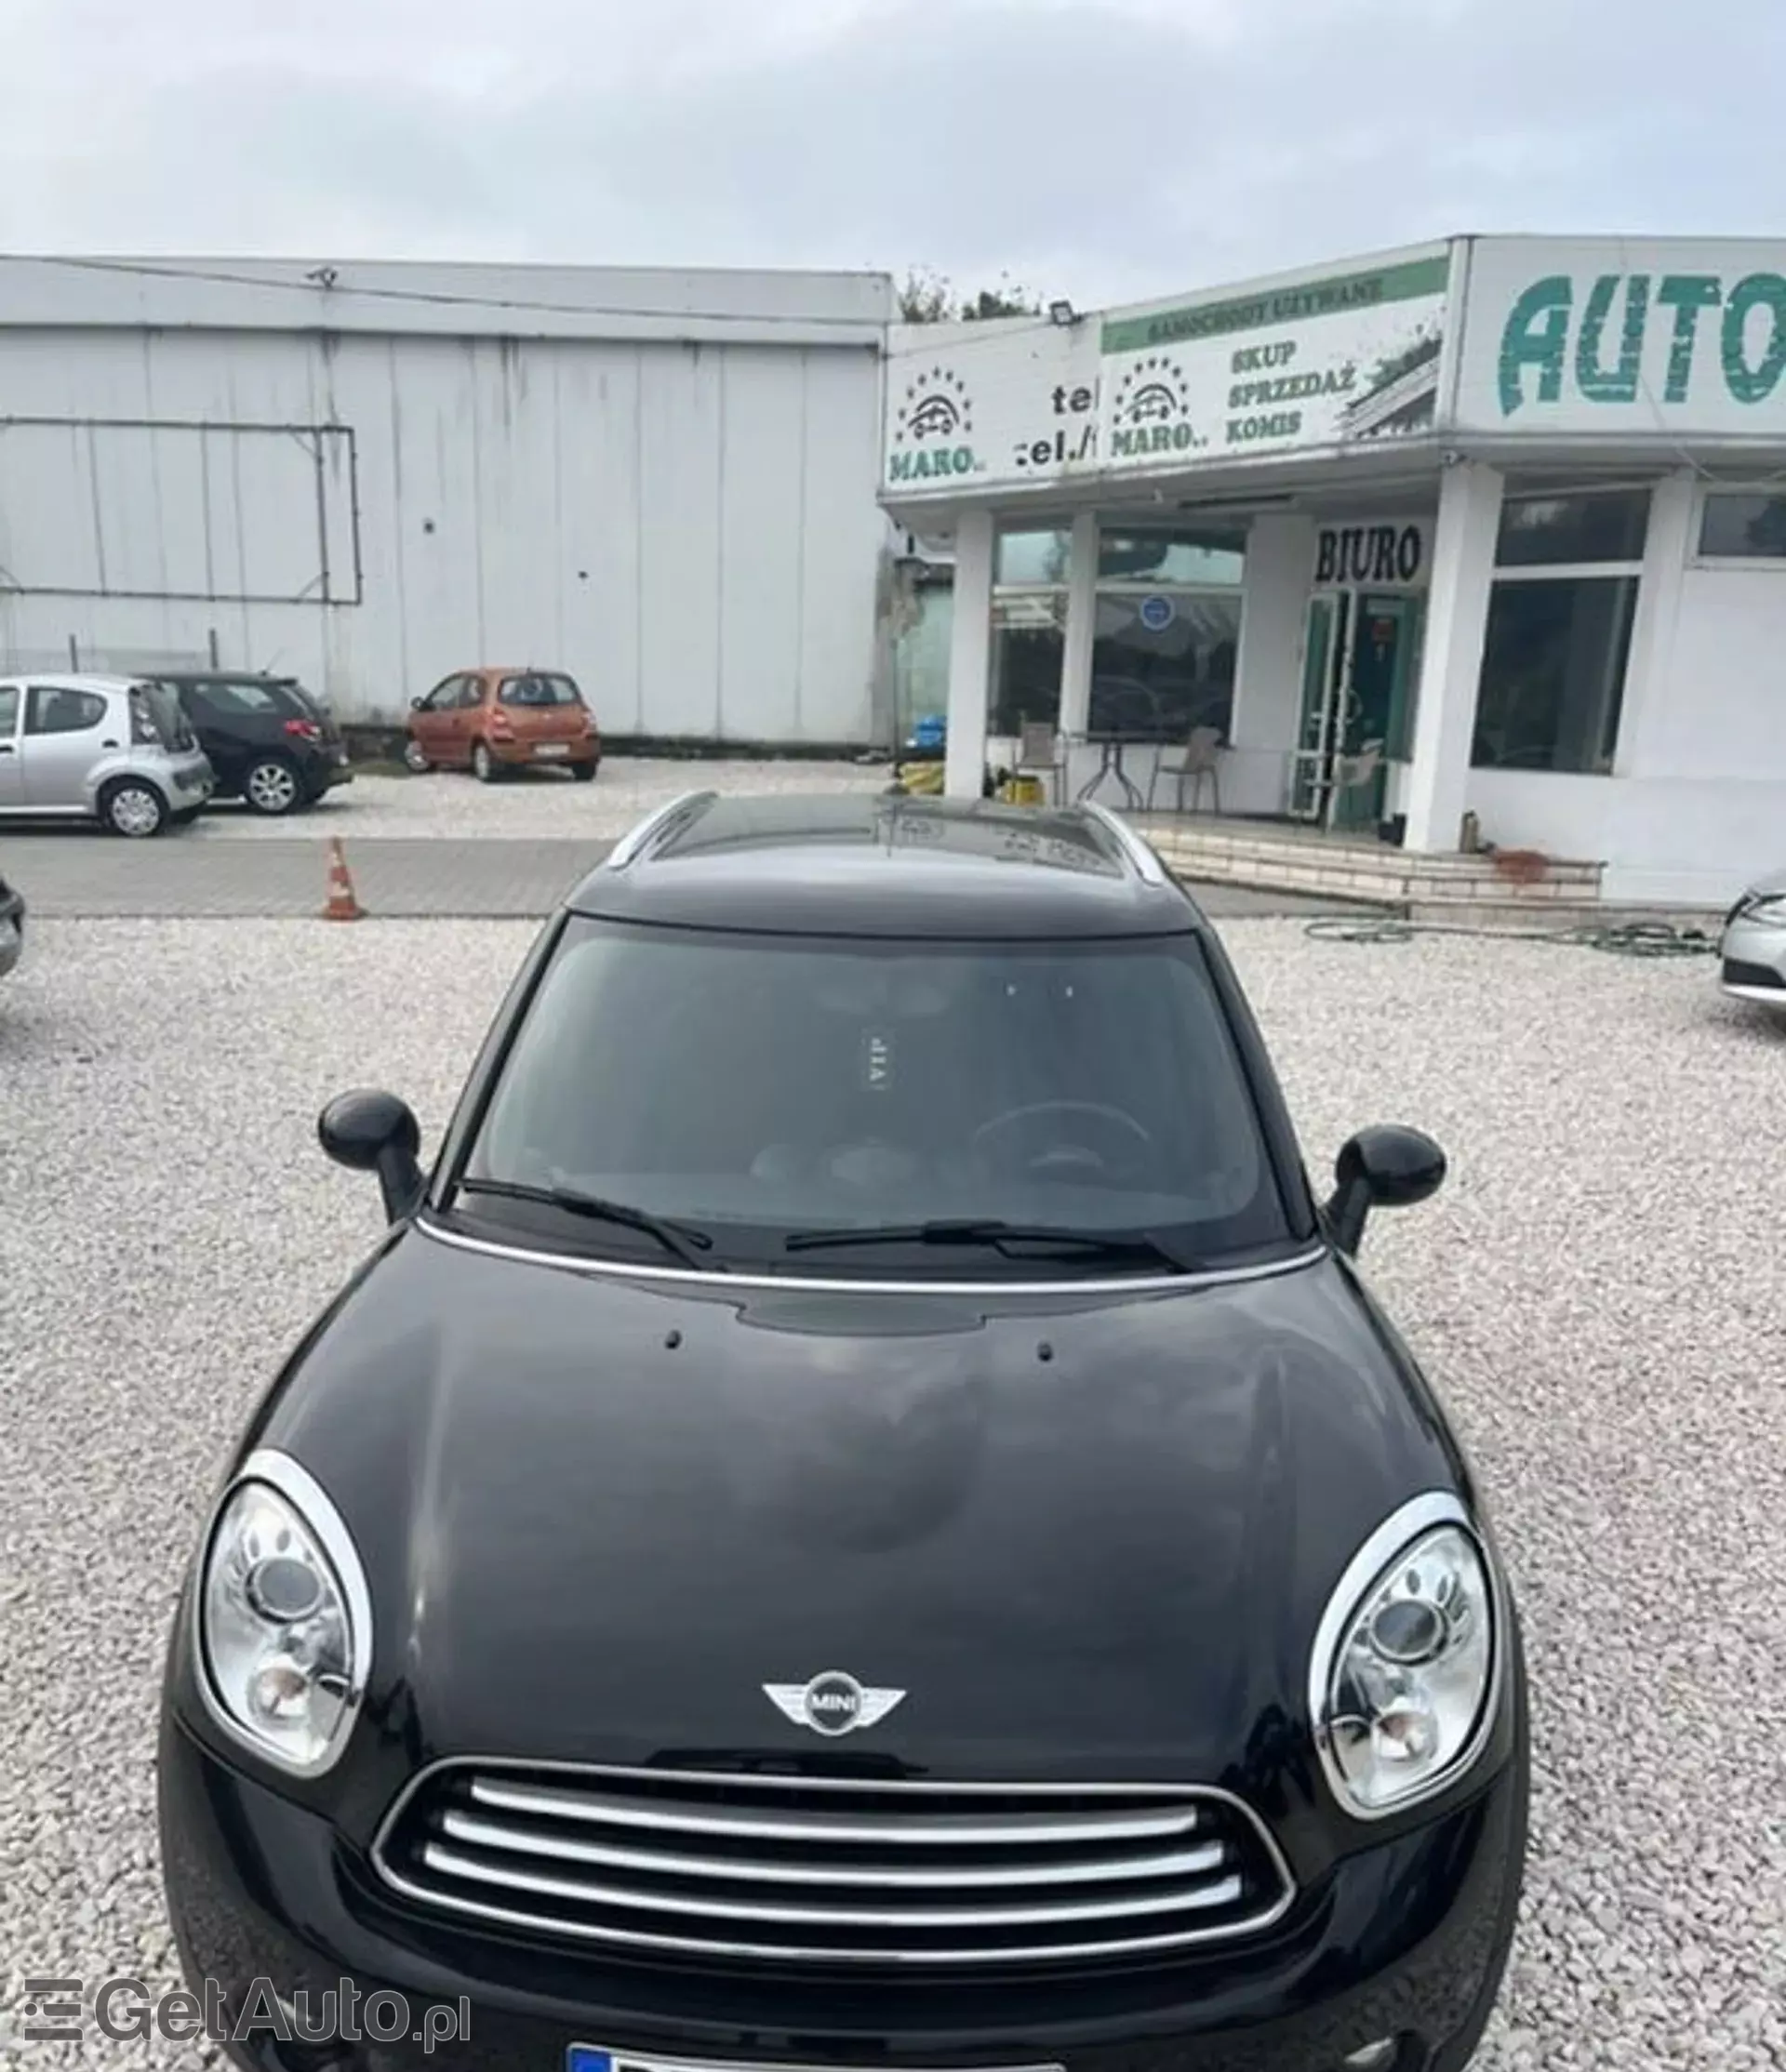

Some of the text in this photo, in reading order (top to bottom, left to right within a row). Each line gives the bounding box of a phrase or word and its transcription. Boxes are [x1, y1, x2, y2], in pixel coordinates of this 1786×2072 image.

[1232, 339, 1297, 375] SKUP
[1499, 272, 1786, 418] AUTO
[1228, 360, 1358, 409] SPRZEDAŻ
[1226, 410, 1302, 445] KOMIS
[1314, 524, 1421, 583] BIURO
[810, 1693, 857, 1712] MINI
